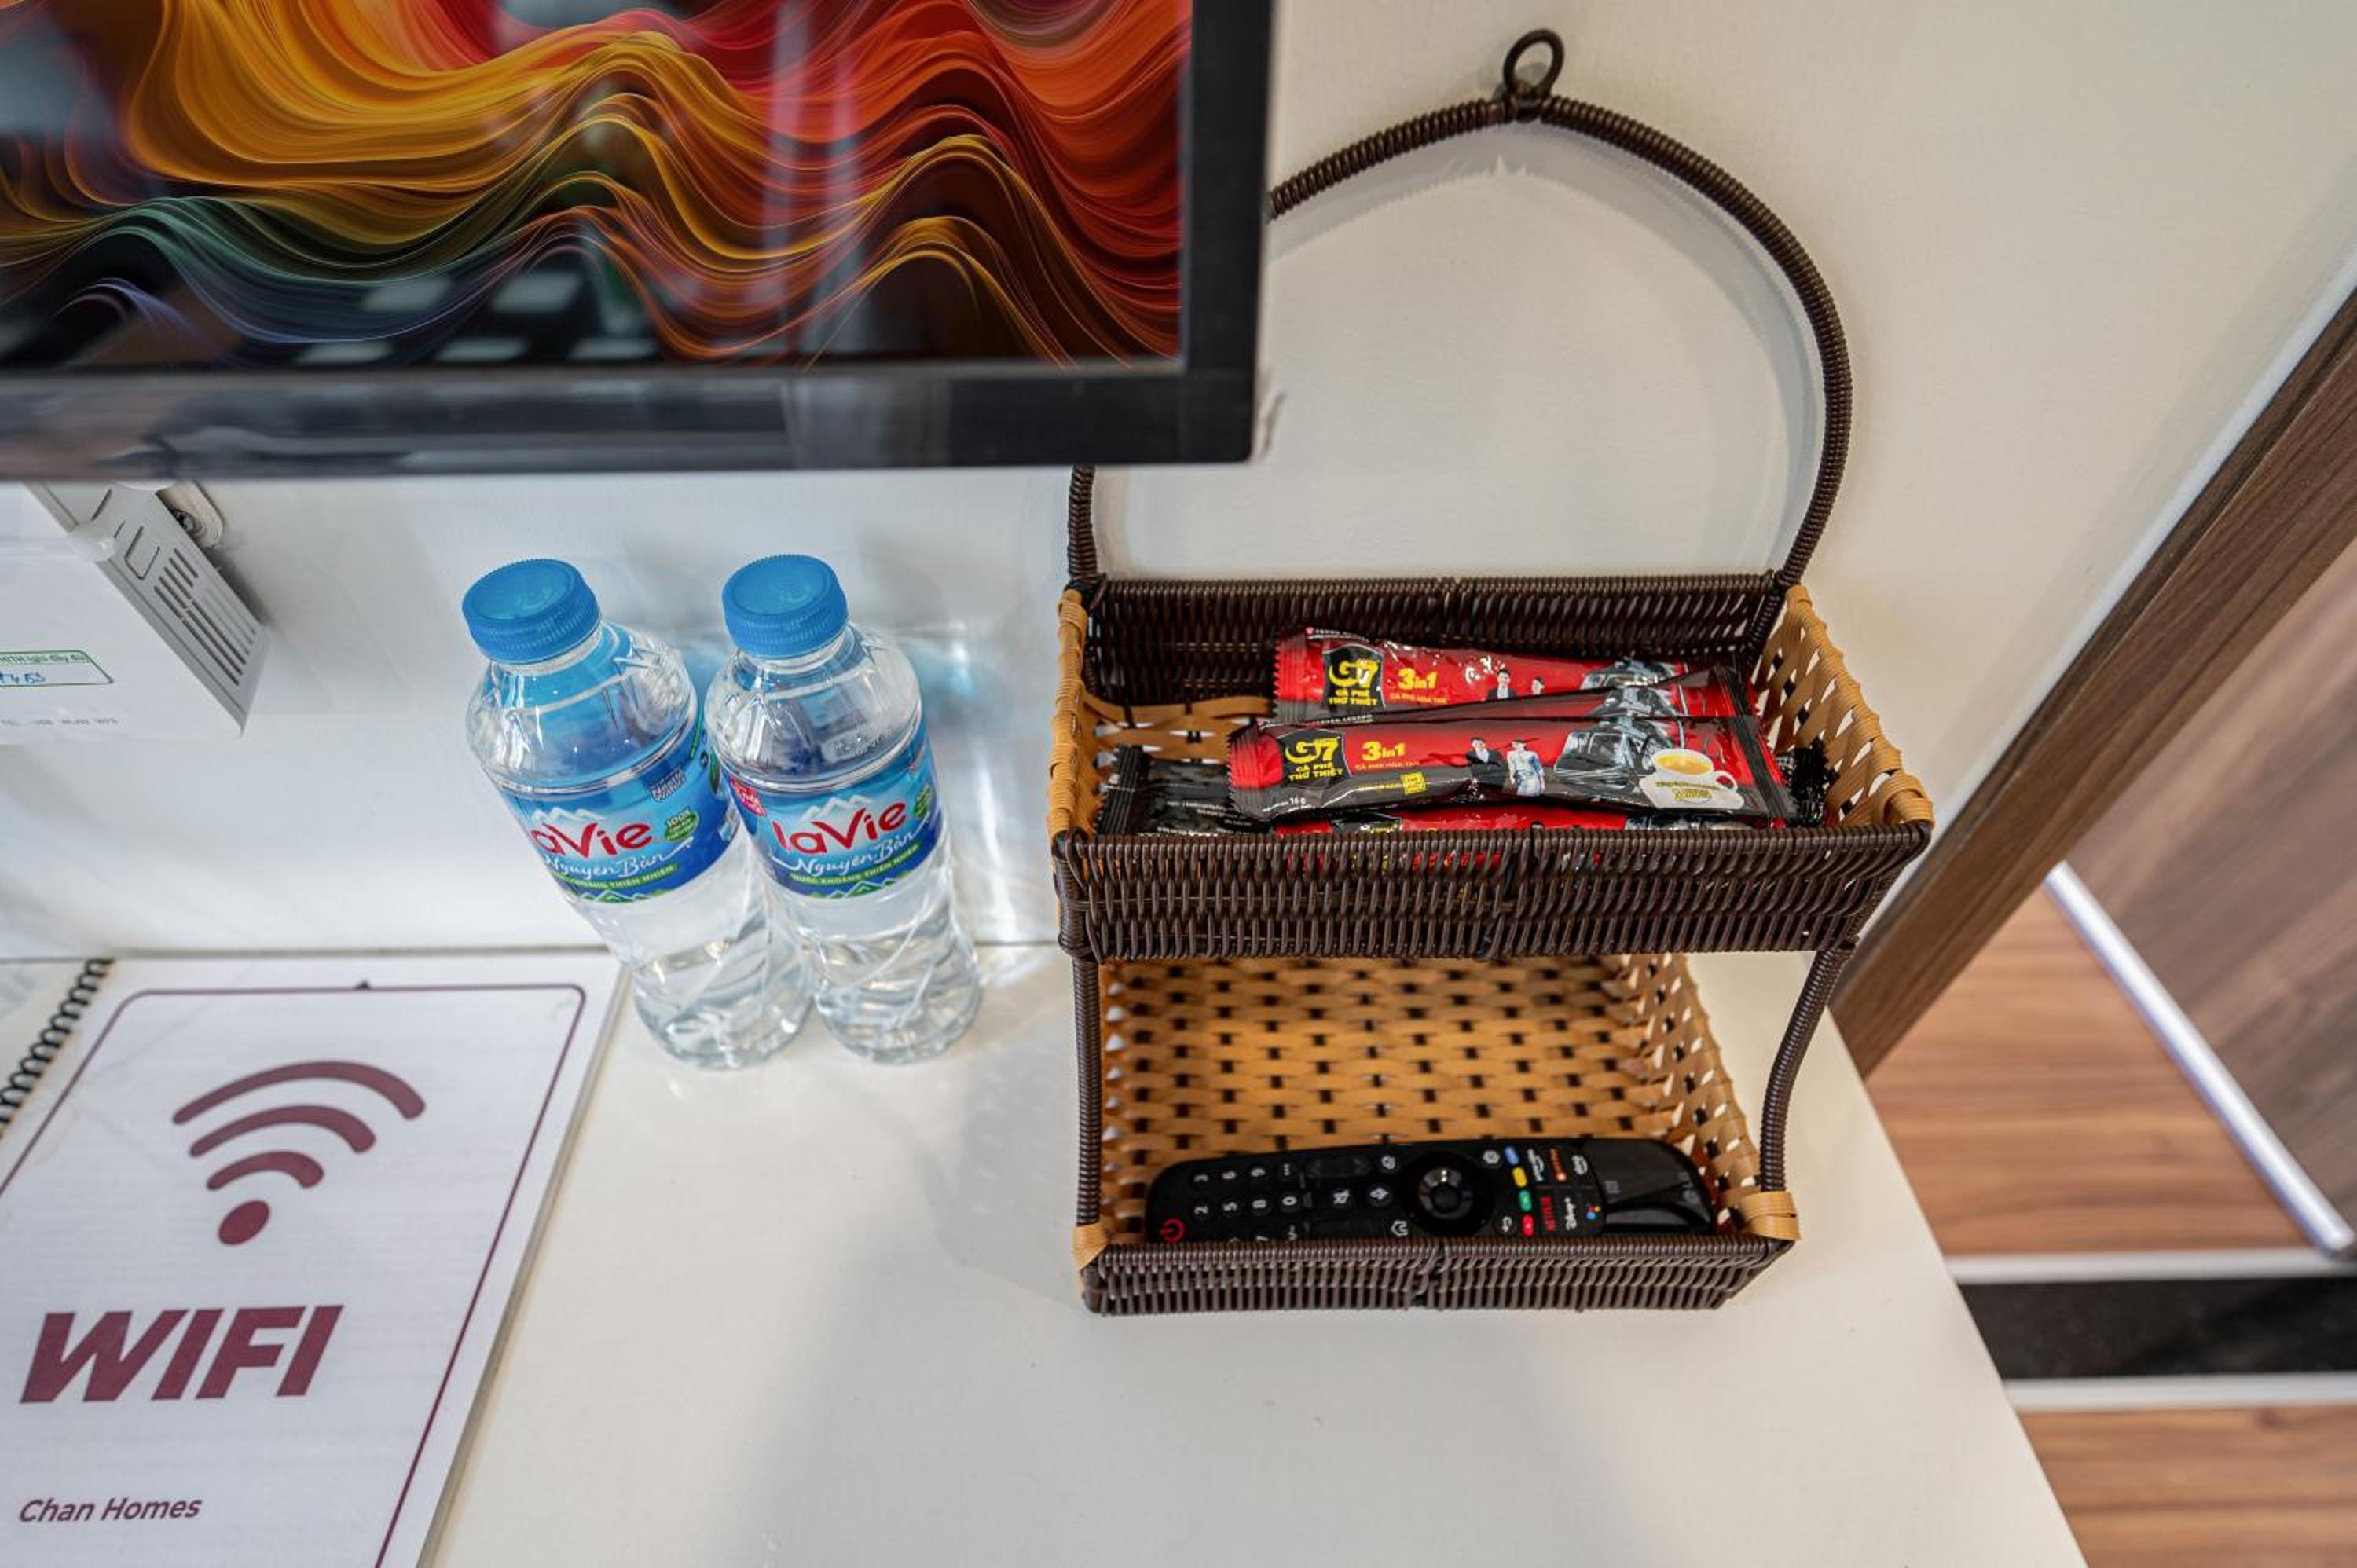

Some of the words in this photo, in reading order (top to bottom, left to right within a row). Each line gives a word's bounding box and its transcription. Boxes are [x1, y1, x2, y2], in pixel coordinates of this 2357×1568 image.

[1398, 668, 1438, 690] 3in1
[1285, 737, 1338, 764] G7
[1362, 741, 1406, 761] 3in1
[530, 822, 654, 859] aVie
[772, 802, 906, 854] laVie
[20, 1305, 344, 1403] WIFI
[18, 1497, 93, 1522] Chan
[101, 1497, 203, 1521] Homes
